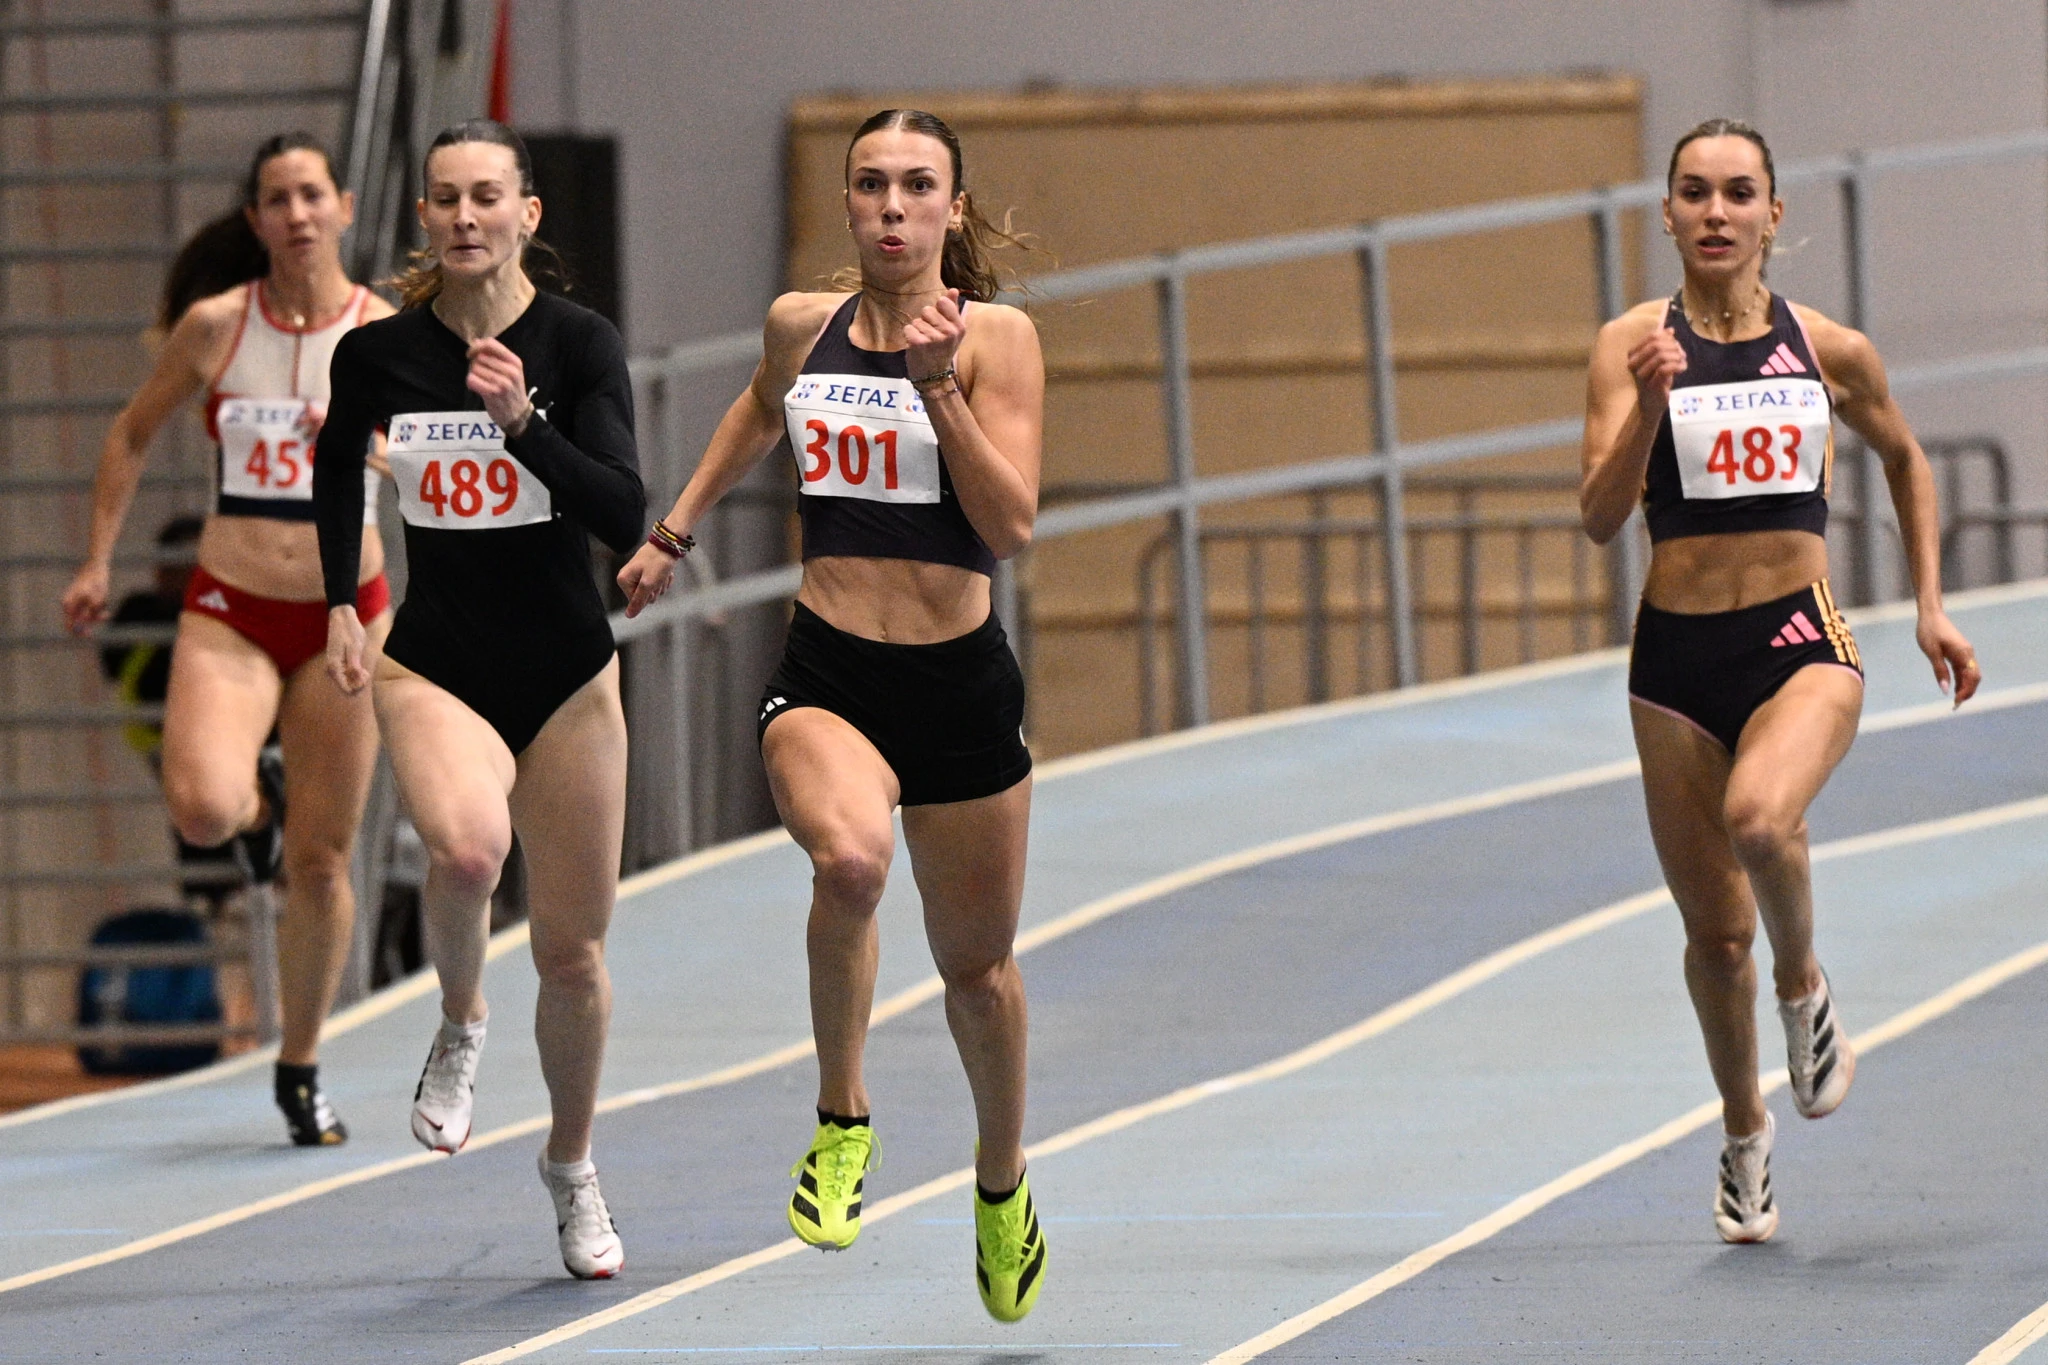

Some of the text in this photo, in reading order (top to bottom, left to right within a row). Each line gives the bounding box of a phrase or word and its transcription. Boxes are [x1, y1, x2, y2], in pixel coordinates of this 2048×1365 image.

[823, 384, 899, 409] ΣΕΓΑΣ
[1713, 389, 1793, 411] ΣΕΓΑΣ
[426, 422, 503, 441] ΣΕΓΑΣ
[804, 419, 899, 490] 301
[1705, 424, 1803, 486] 483
[419, 458, 519, 519] 489
